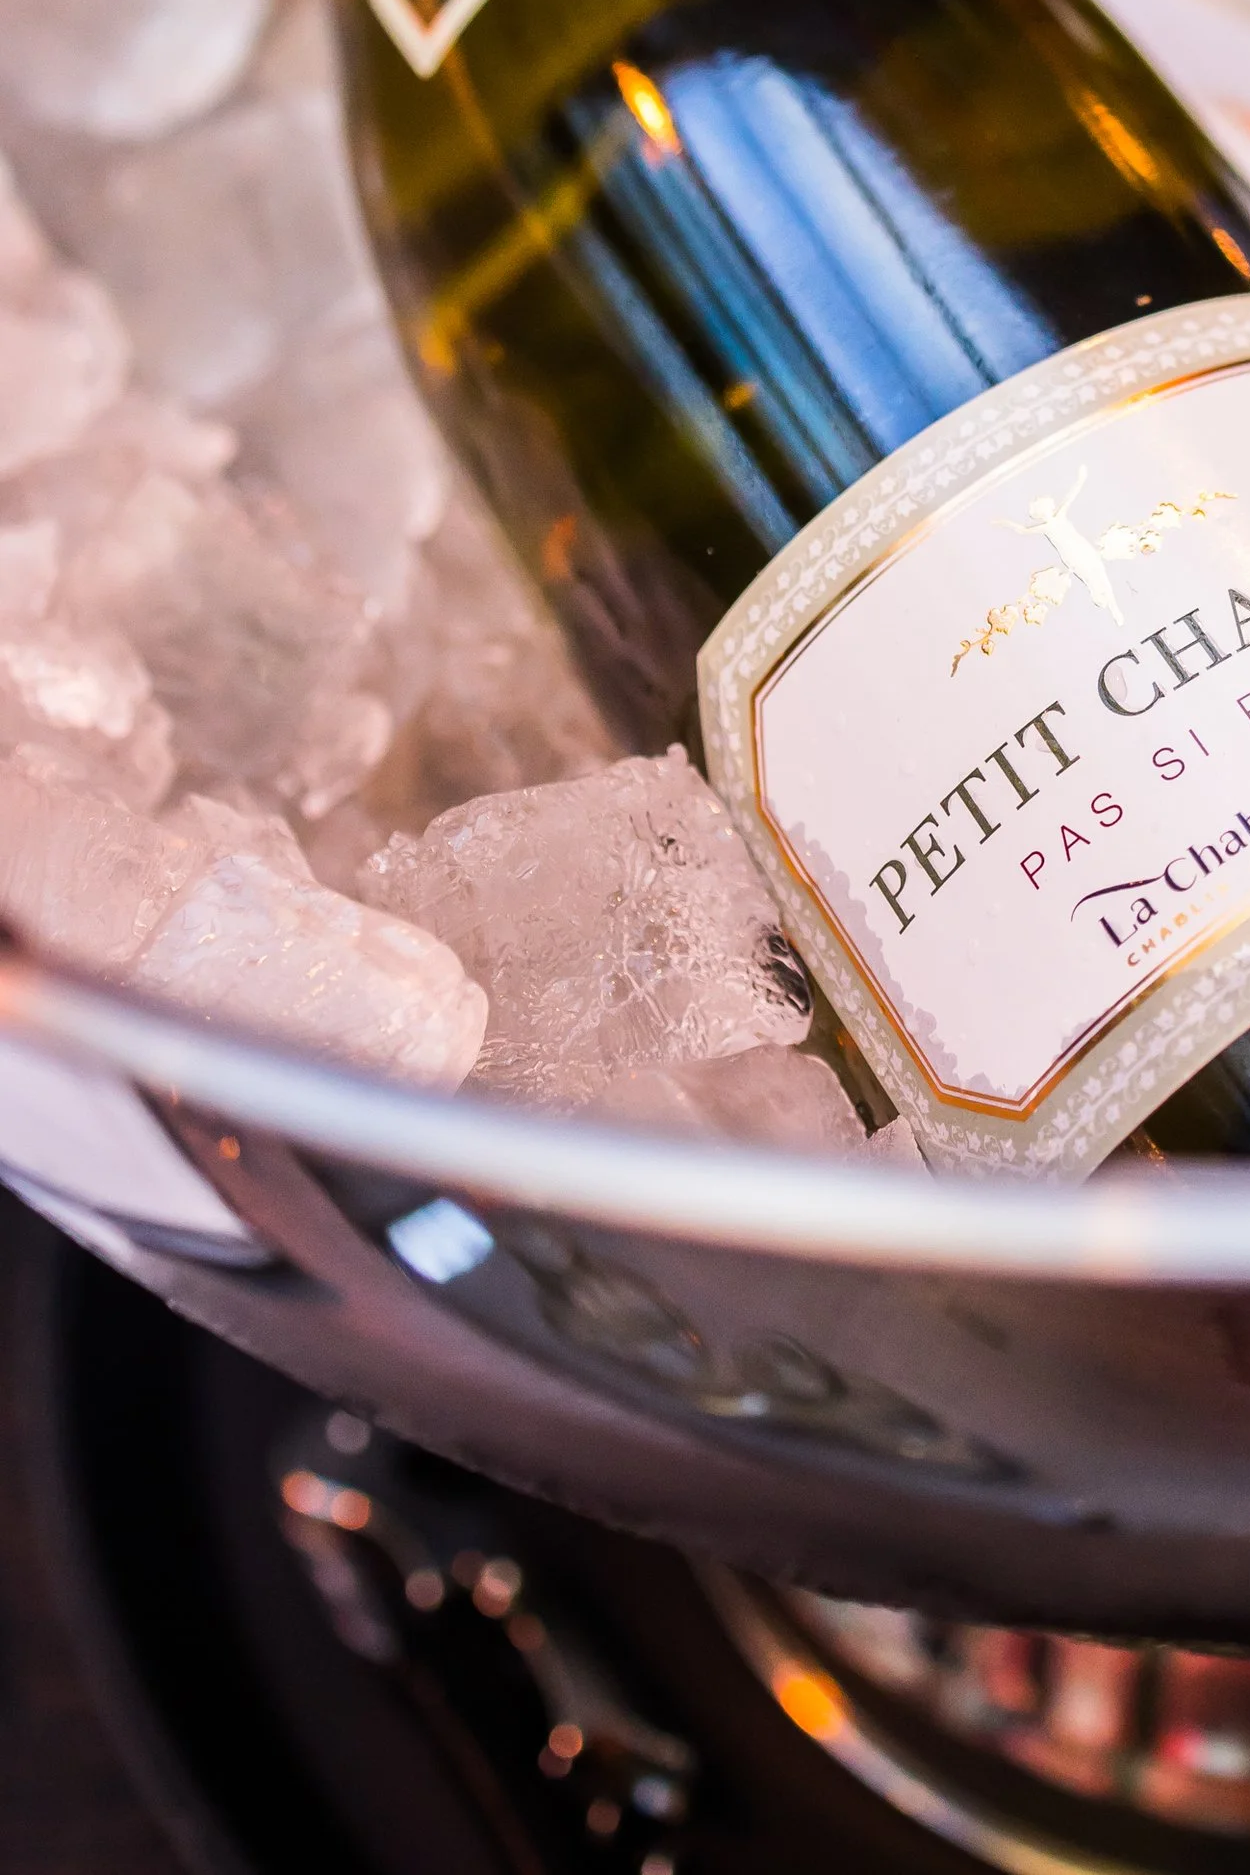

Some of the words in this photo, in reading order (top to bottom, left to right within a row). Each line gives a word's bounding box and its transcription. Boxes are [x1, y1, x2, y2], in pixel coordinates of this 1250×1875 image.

[868, 701, 1081, 935] PETIT
[1018, 791, 1125, 891] PAS
[1151, 727, 1210, 781] SI
[1097, 896, 1160, 949] La
